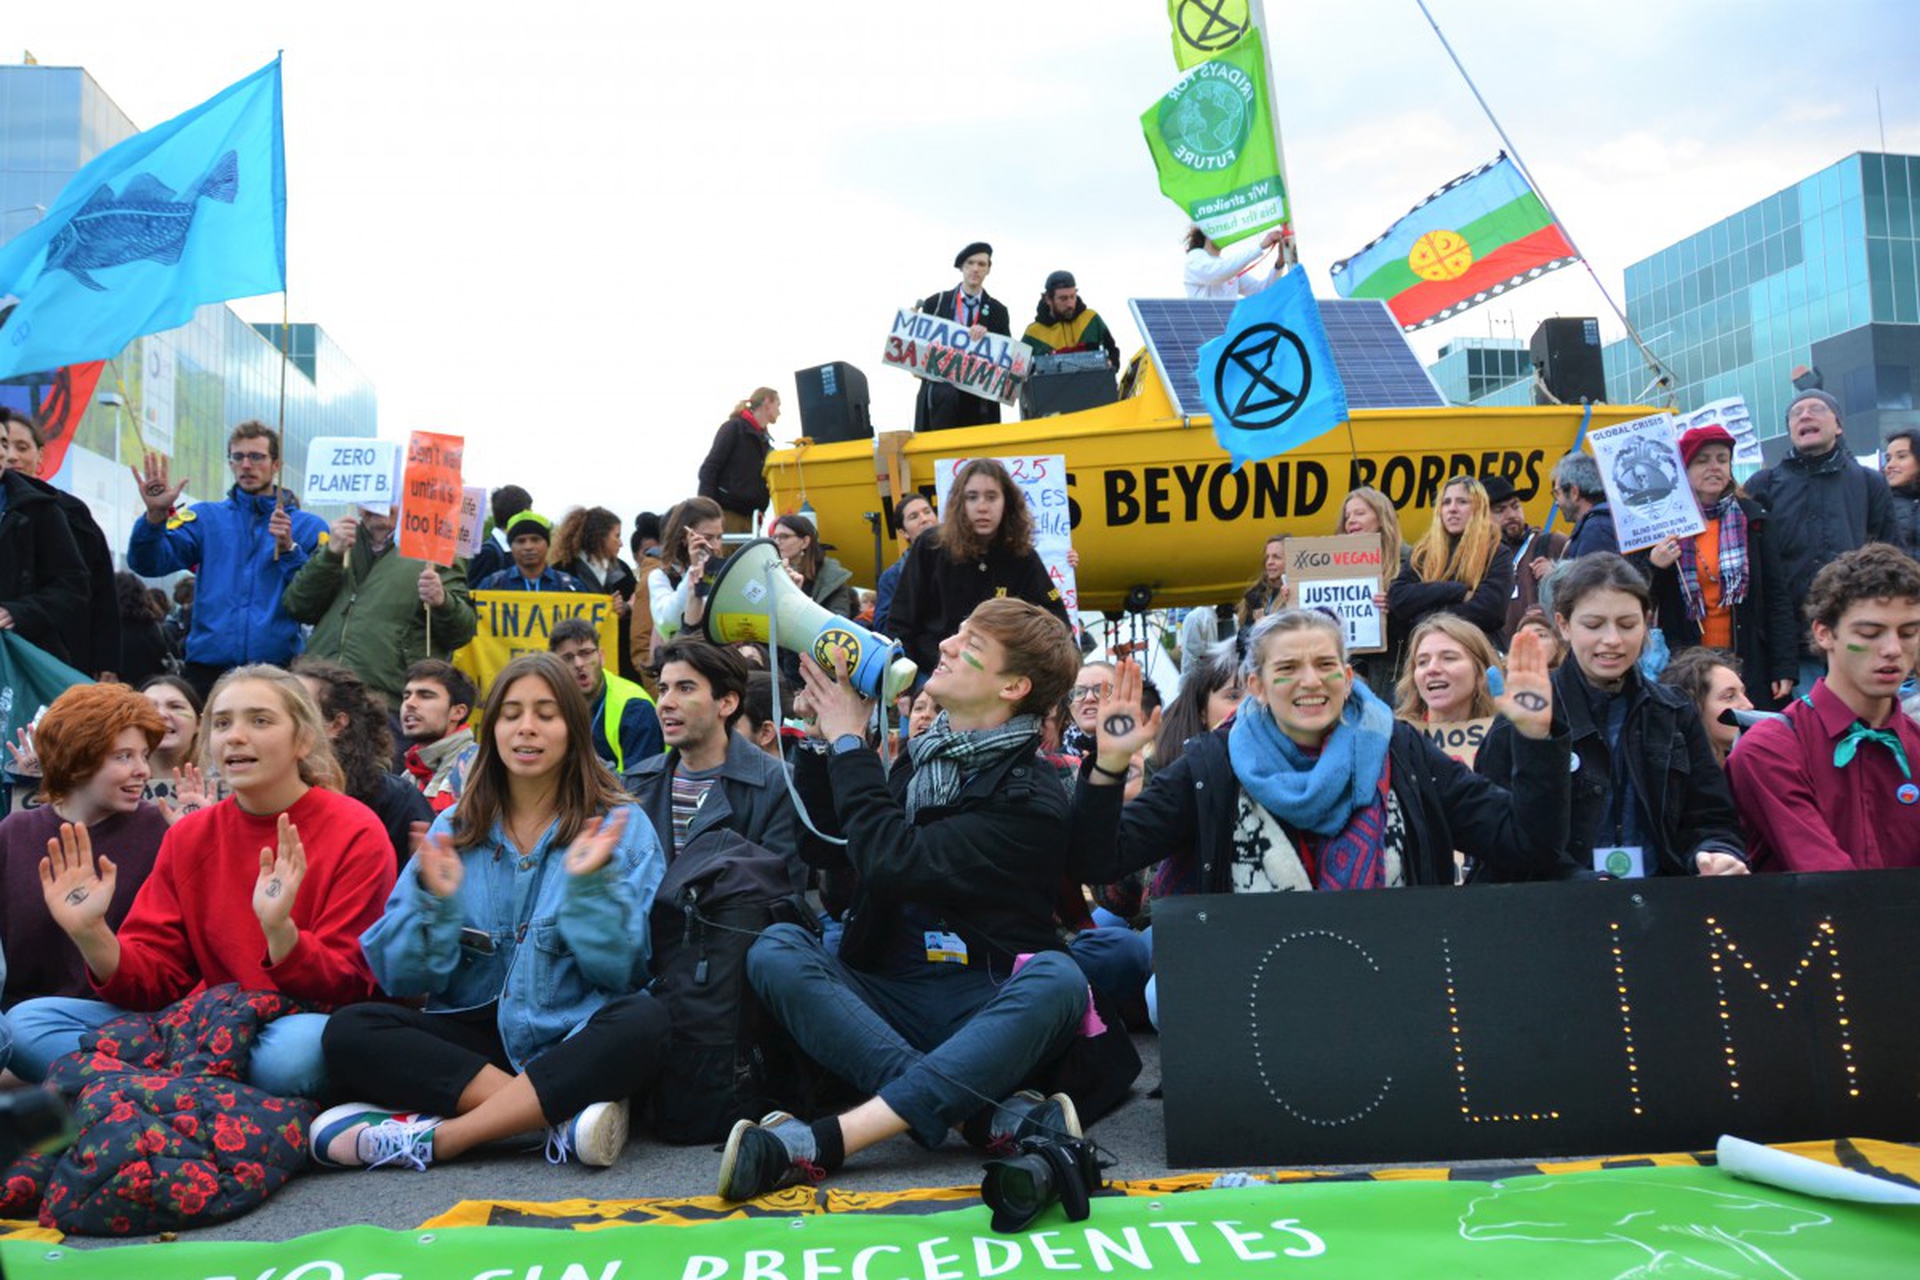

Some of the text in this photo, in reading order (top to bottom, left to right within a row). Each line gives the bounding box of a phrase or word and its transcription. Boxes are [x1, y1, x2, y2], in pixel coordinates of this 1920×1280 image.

[885, 336, 917, 367] ЗА
[892, 310, 1014, 371] МОЛОДЬ
[1593, 417, 1664, 441] GLOBAL CRISIS
[331, 448, 376, 466] ZERO
[308, 474, 391, 492] PLANET B.
[1104, 461, 1329, 528] BEYOND
[405, 509, 430, 533] too
[1332, 547, 1381, 565] VEGAN
[1304, 585, 1372, 604] JUSTICIA
